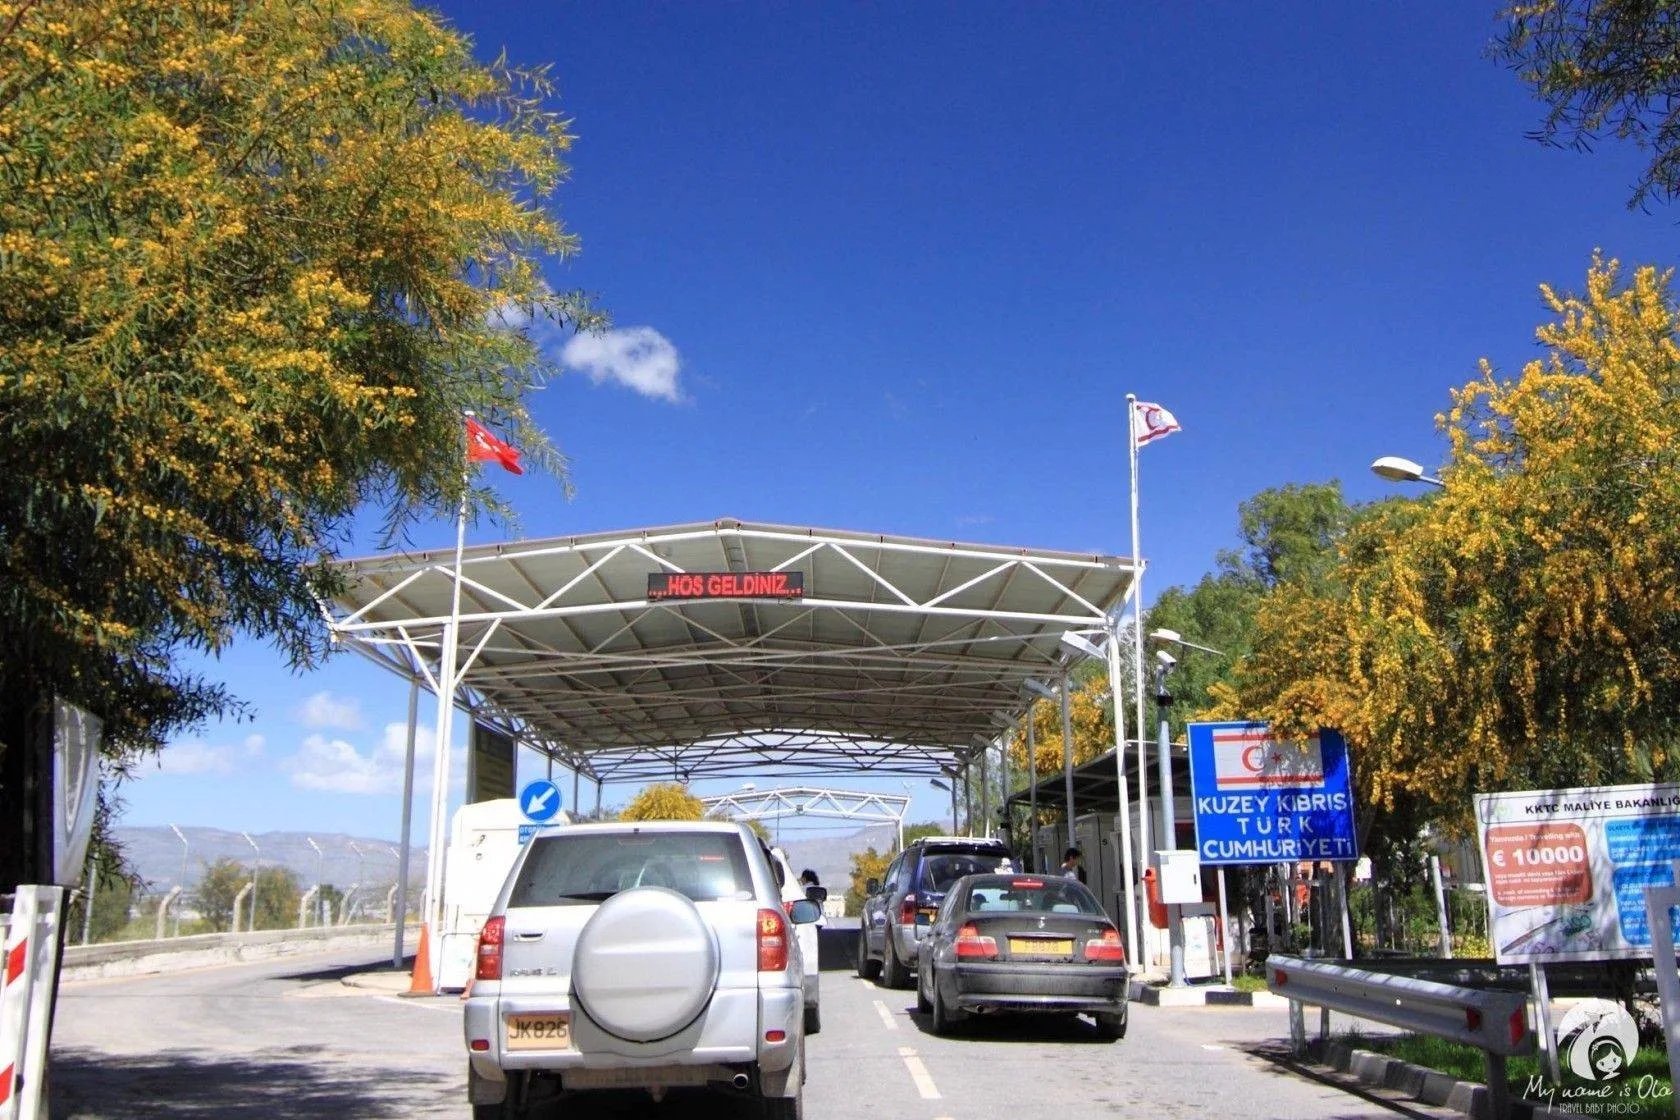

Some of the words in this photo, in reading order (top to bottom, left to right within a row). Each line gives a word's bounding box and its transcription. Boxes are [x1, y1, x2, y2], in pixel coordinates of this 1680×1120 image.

[1198, 795, 1270, 815] KUZEY
[1277, 792, 1347, 813] KIBRIS
[1525, 803, 1560, 814] KKTC
[1563, 799, 1612, 812] MALİYE
[1492, 849, 1507, 867] €
[1512, 845, 1584, 866] 10000
